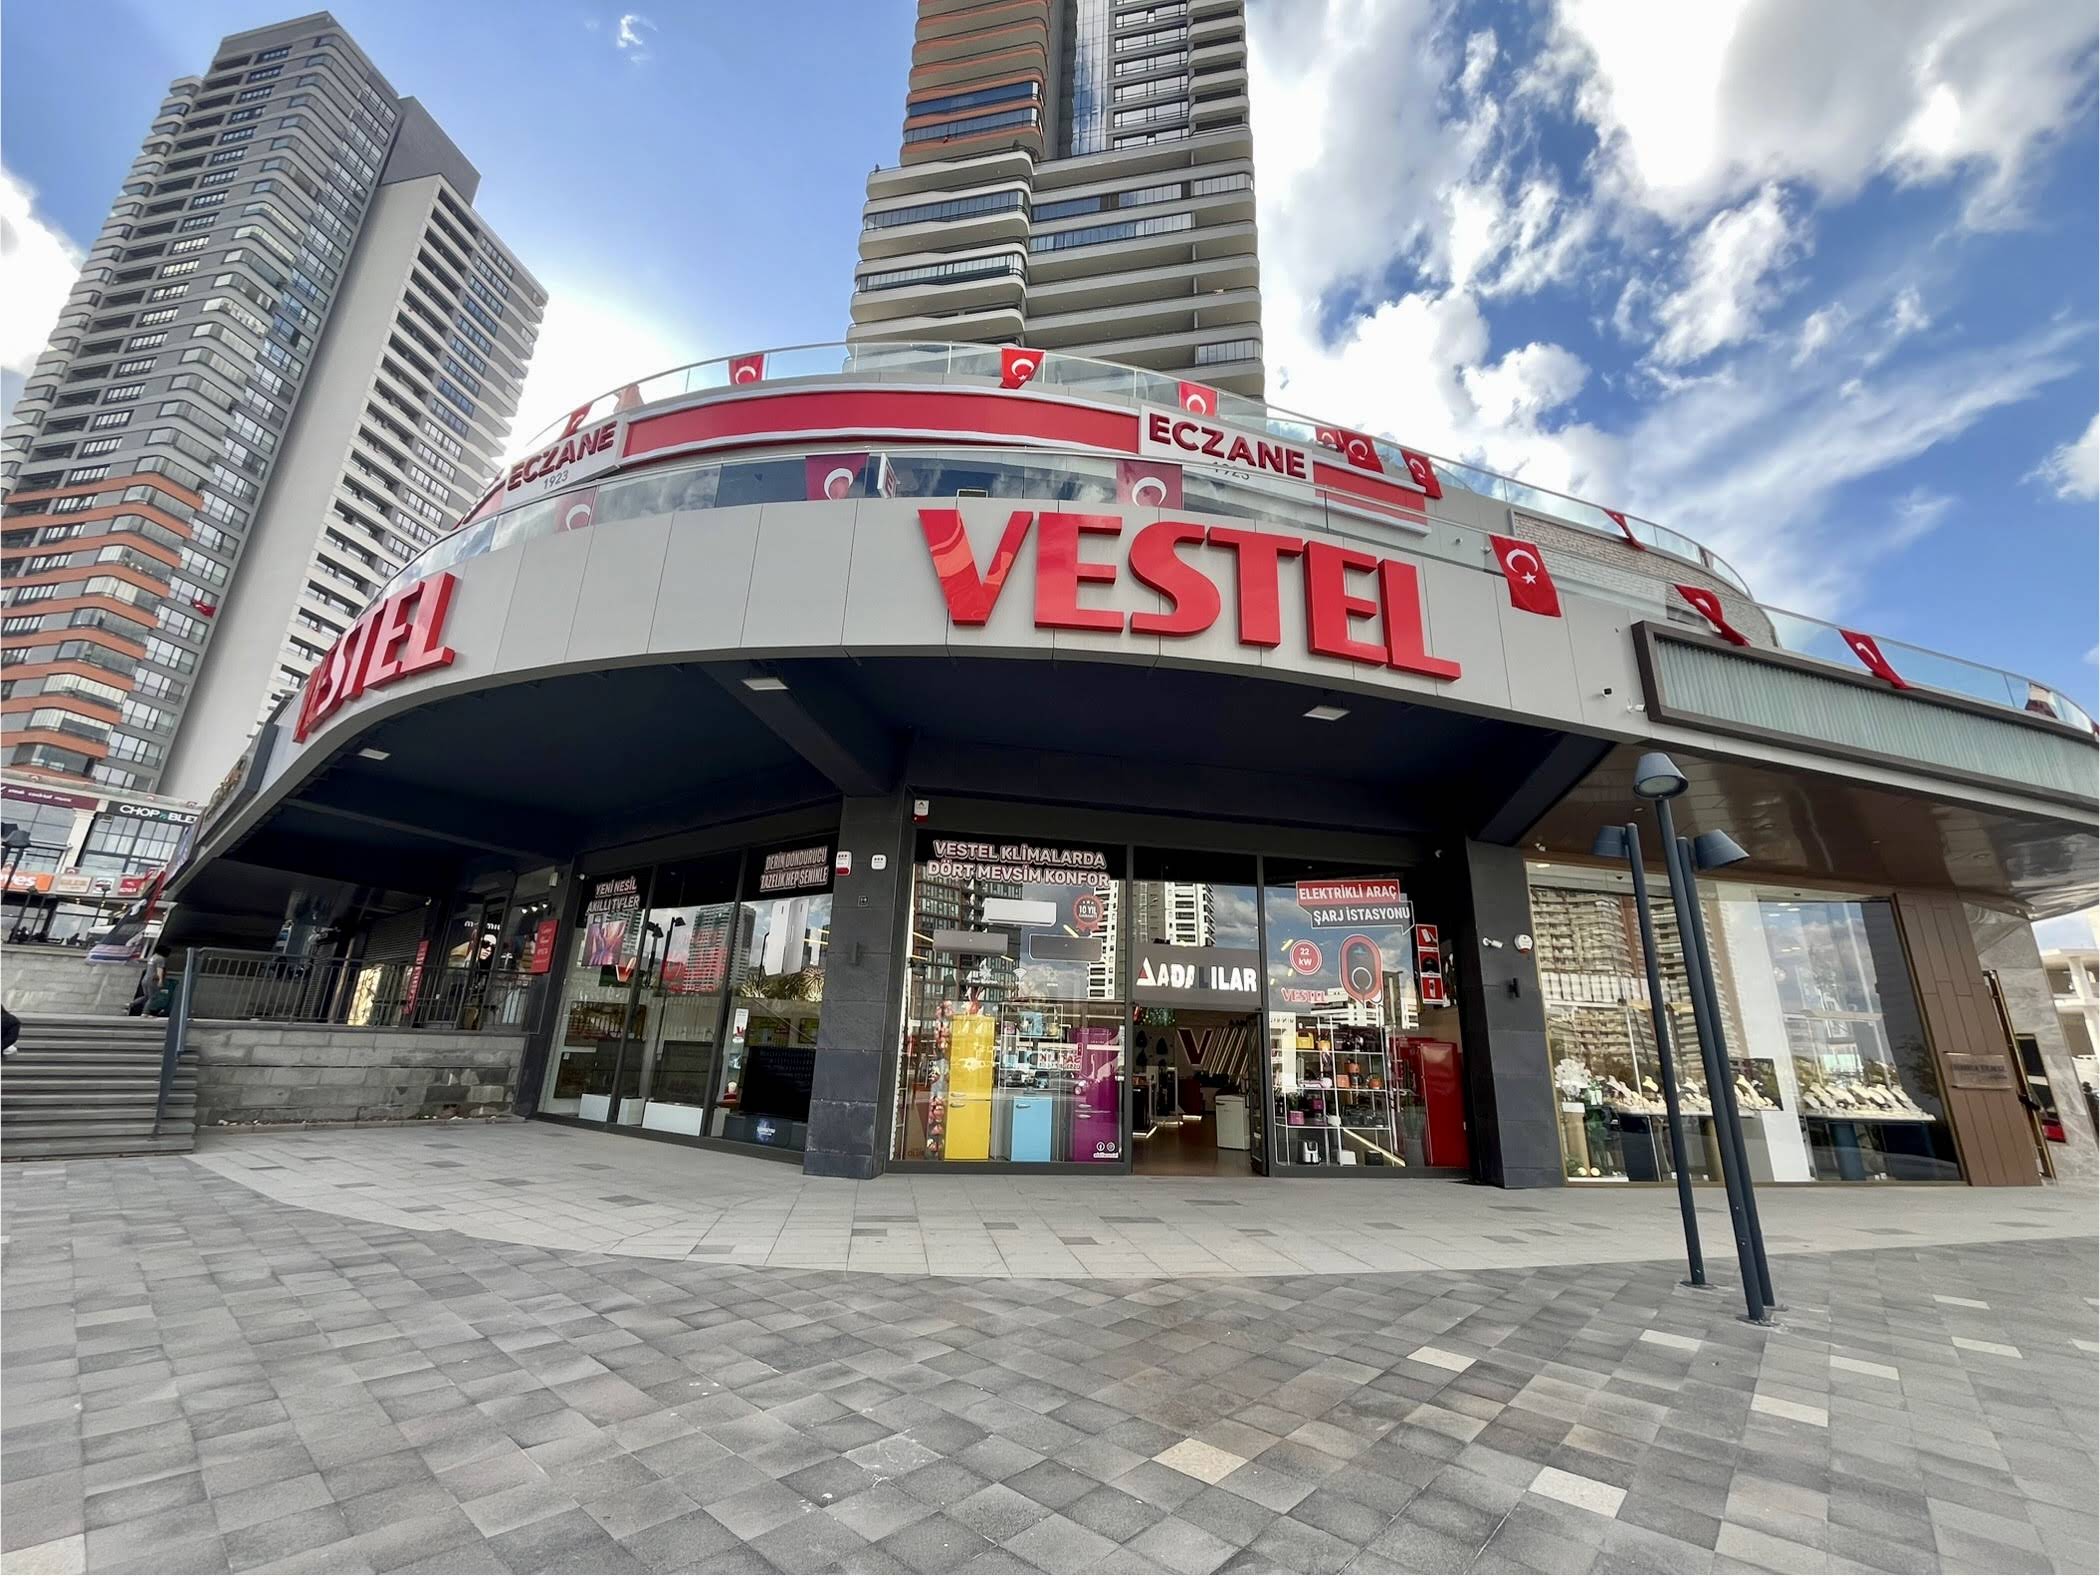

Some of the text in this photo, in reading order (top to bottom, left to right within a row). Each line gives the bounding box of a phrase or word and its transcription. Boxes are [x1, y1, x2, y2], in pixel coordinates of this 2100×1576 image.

[507, 421, 618, 491] ECZANE
[1150, 413, 1307, 479] ECZANE
[543, 470, 569, 490] 1923
[918, 508, 1462, 682] VESTEL
[293, 572, 456, 744] VESTEL
[119, 804, 160, 818] CHOP
[167, 812, 199, 824] BLE
[933, 841, 1106, 868] VESTEL KLİMALARDA
[614, 876, 638, 893] NESİL
[928, 859, 1110, 888] DÖRT MEVSİM KONFOR
[1299, 884, 1397, 900] ELEKTRİKLİ ARAÇ
[1079, 904, 1087, 914] 10
[1312, 907, 1410, 925] ŞARJ İSTASYONU
